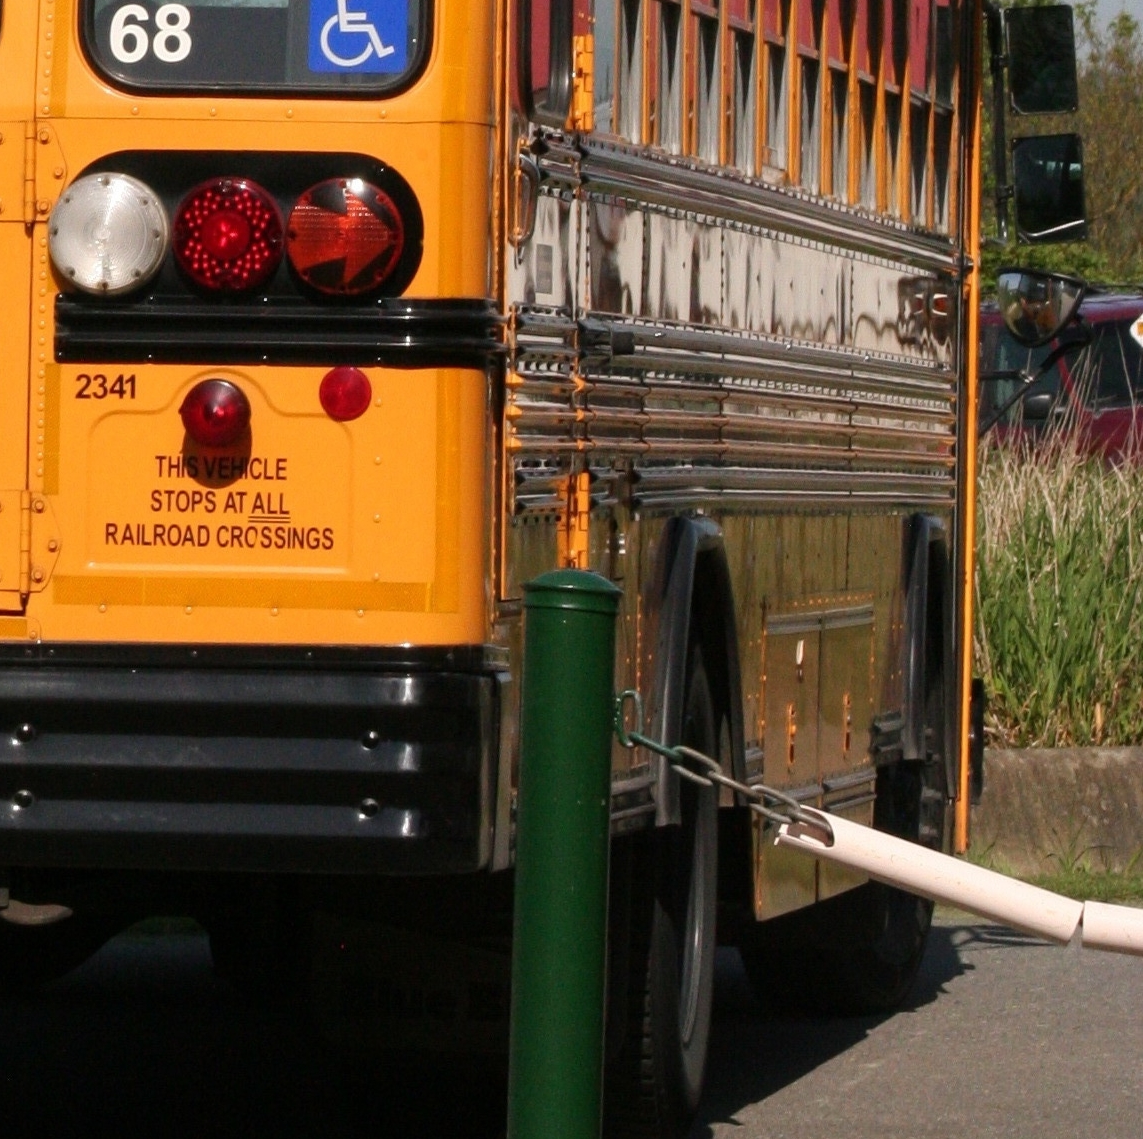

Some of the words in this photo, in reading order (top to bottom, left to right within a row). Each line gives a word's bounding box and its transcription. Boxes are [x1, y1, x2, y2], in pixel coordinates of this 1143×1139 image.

[109, 3, 192, 63] 68
[75, 374, 136, 399] 2341
[155, 455, 199, 478] THIS
[203, 456, 287, 480] VEHICLE
[150, 490, 216, 513] STOPS
[223, 491, 247, 513] AT
[251, 492, 290, 515] ALL
[105, 523, 210, 547] RAILROAD
[216, 525, 334, 550] CROSSINGS
